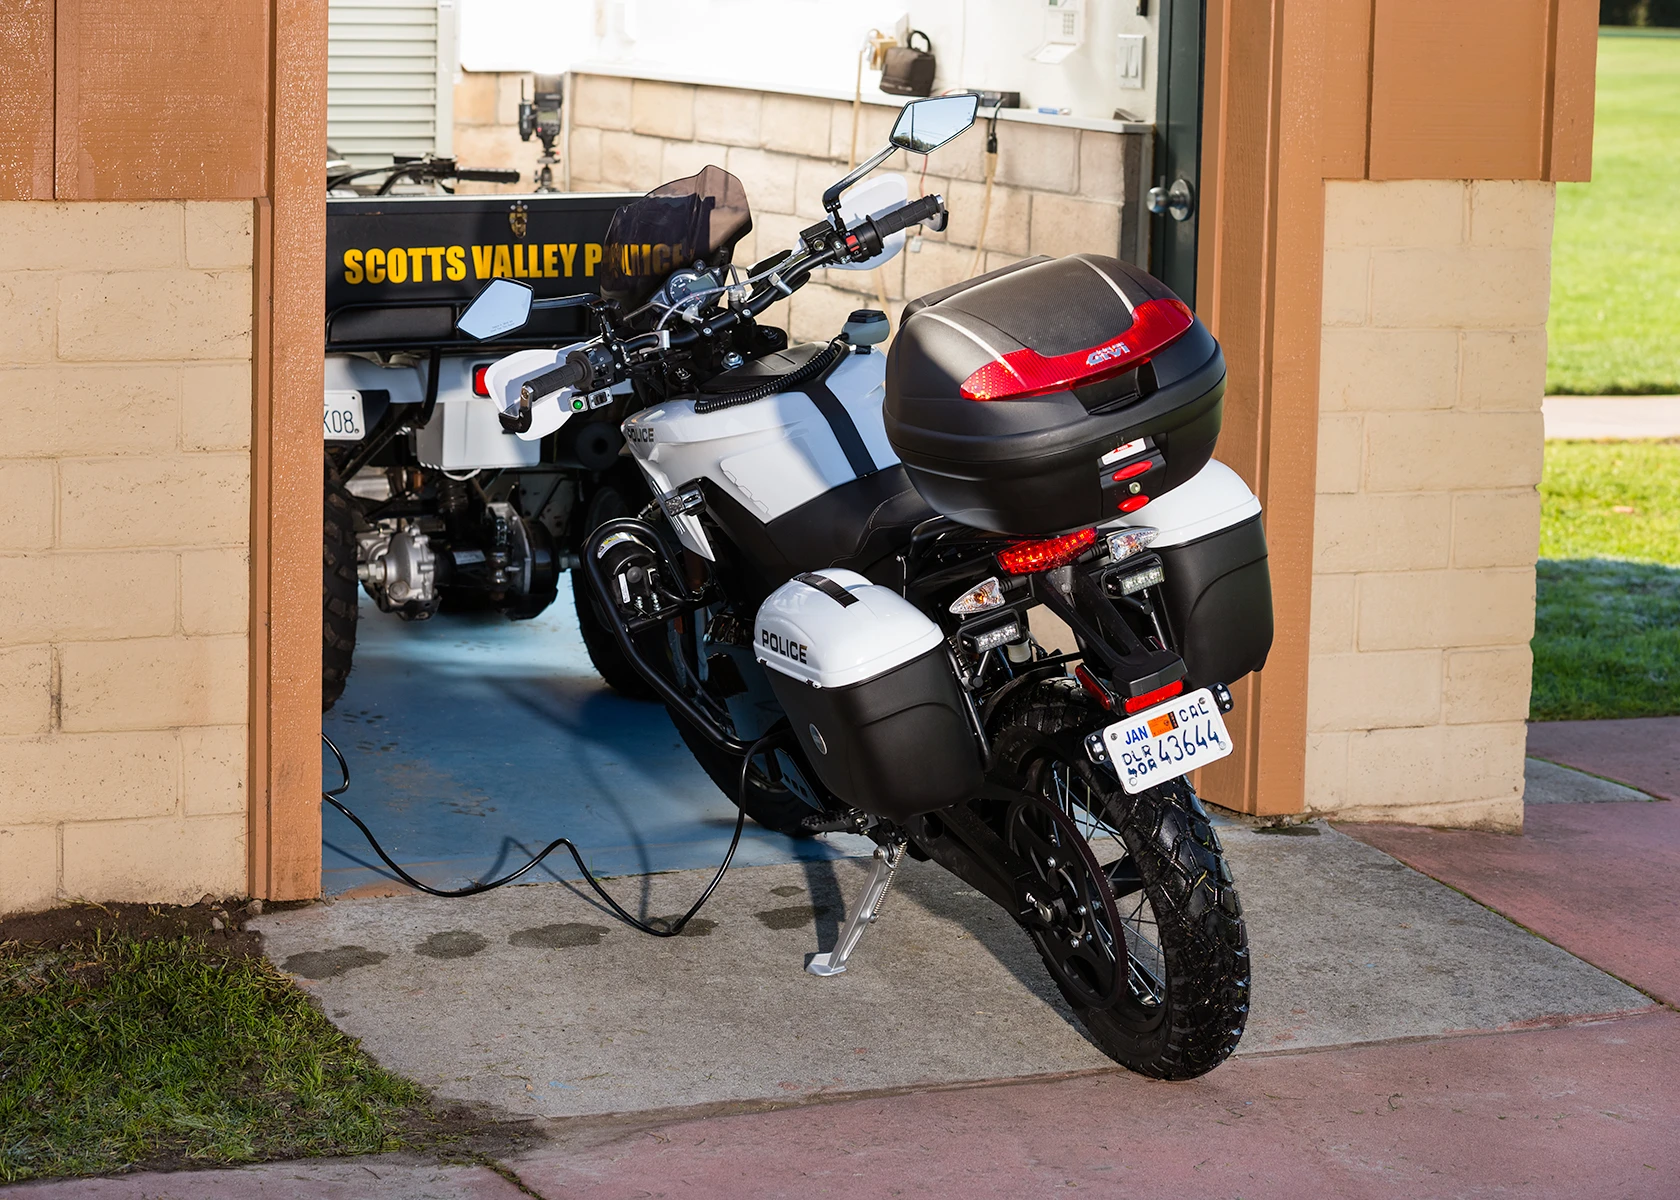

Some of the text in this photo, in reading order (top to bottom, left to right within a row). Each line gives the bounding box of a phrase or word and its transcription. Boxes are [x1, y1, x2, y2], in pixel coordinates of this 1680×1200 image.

[343, 245, 467, 285] SCOTTS
[471, 243, 578, 280] VALLEY
[1086, 341, 1130, 367] GIVI
[627, 427, 655, 443] POLICE
[761, 628, 808, 665] POLICE
[1125, 725, 1149, 745] JAN
[1178, 702, 1210, 722] CAL
[1158, 719, 1220, 765] 43644
